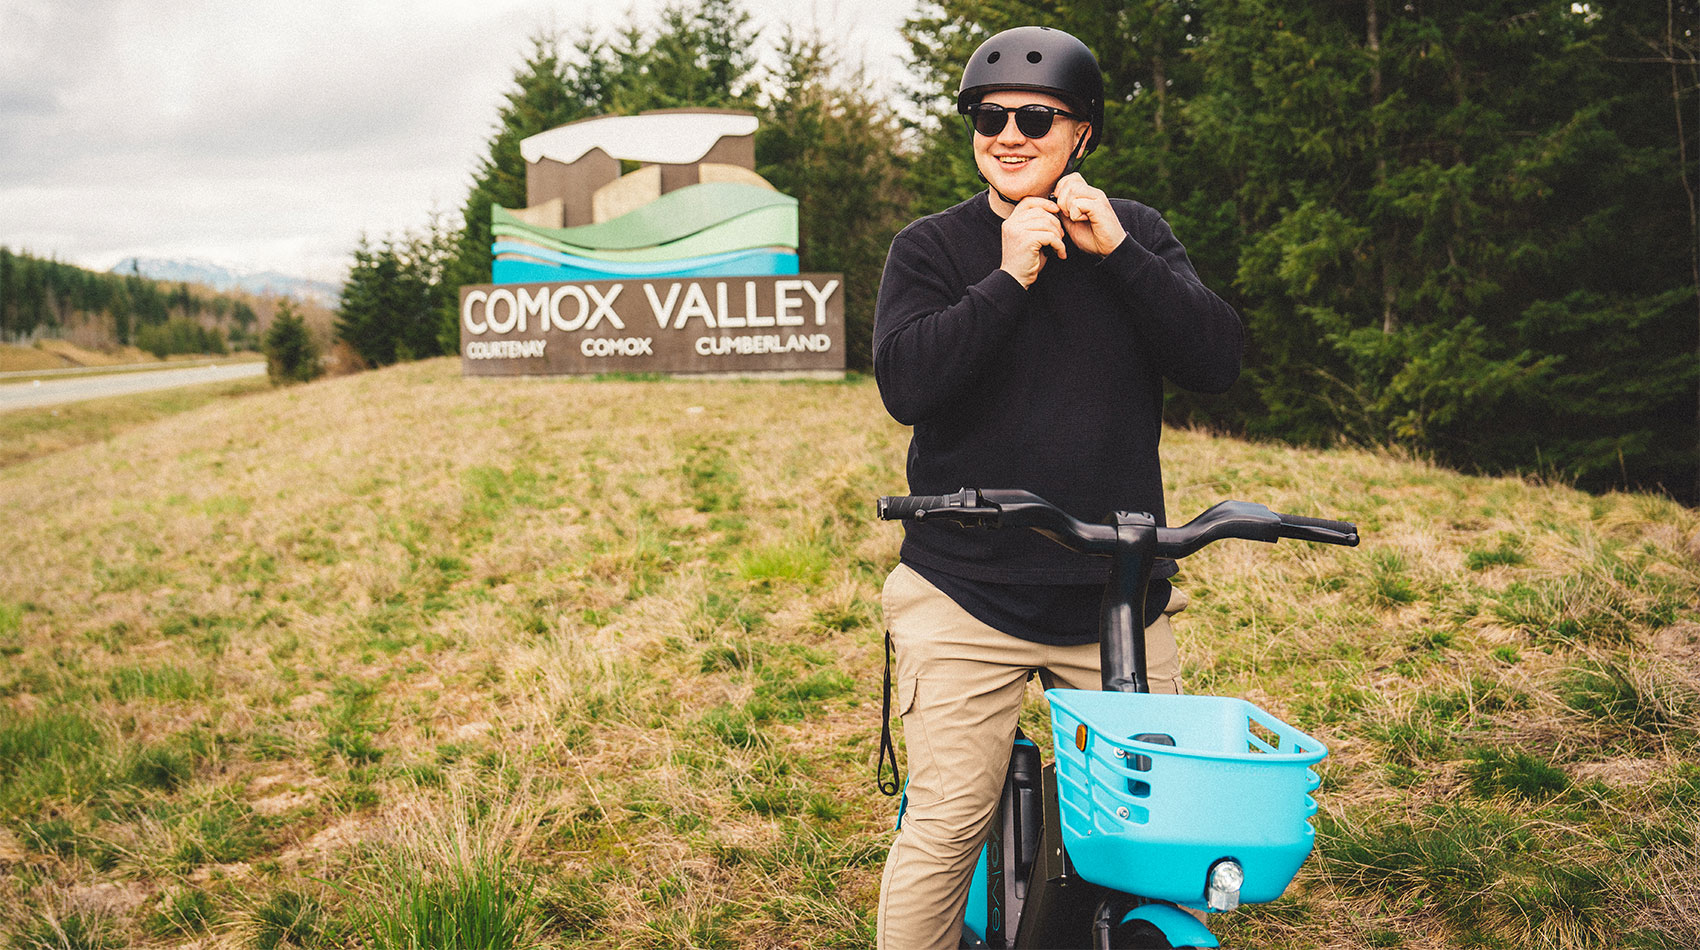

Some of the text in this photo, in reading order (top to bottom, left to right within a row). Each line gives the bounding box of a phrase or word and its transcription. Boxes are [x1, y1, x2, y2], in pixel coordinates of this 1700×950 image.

[463, 279, 840, 335] COMOX VALLEY
[466, 333, 831, 360] COURTENAY COMOX CUMBERLAND
